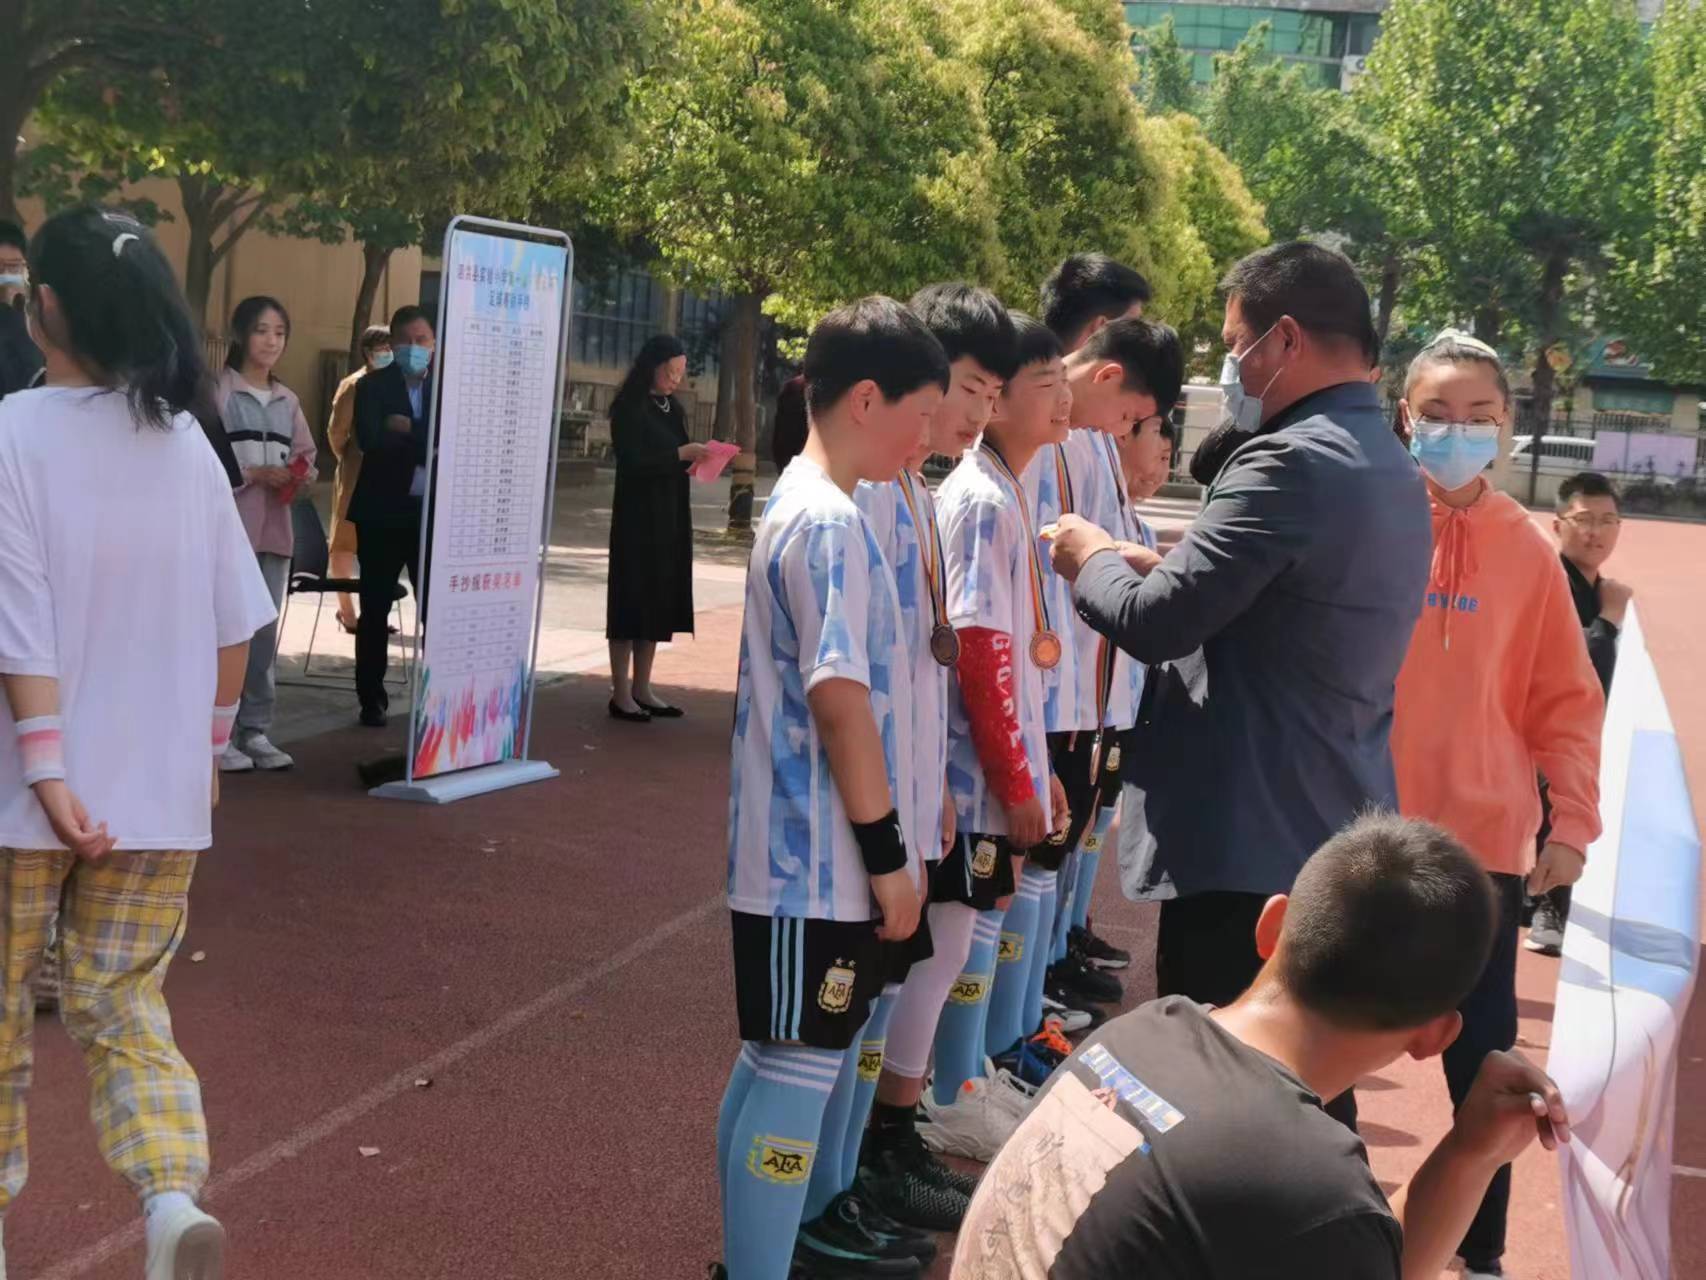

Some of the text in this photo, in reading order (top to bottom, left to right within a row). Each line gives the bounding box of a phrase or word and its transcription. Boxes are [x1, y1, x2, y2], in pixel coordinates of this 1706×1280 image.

[449, 571, 522, 593] 手抄报获奖名单
